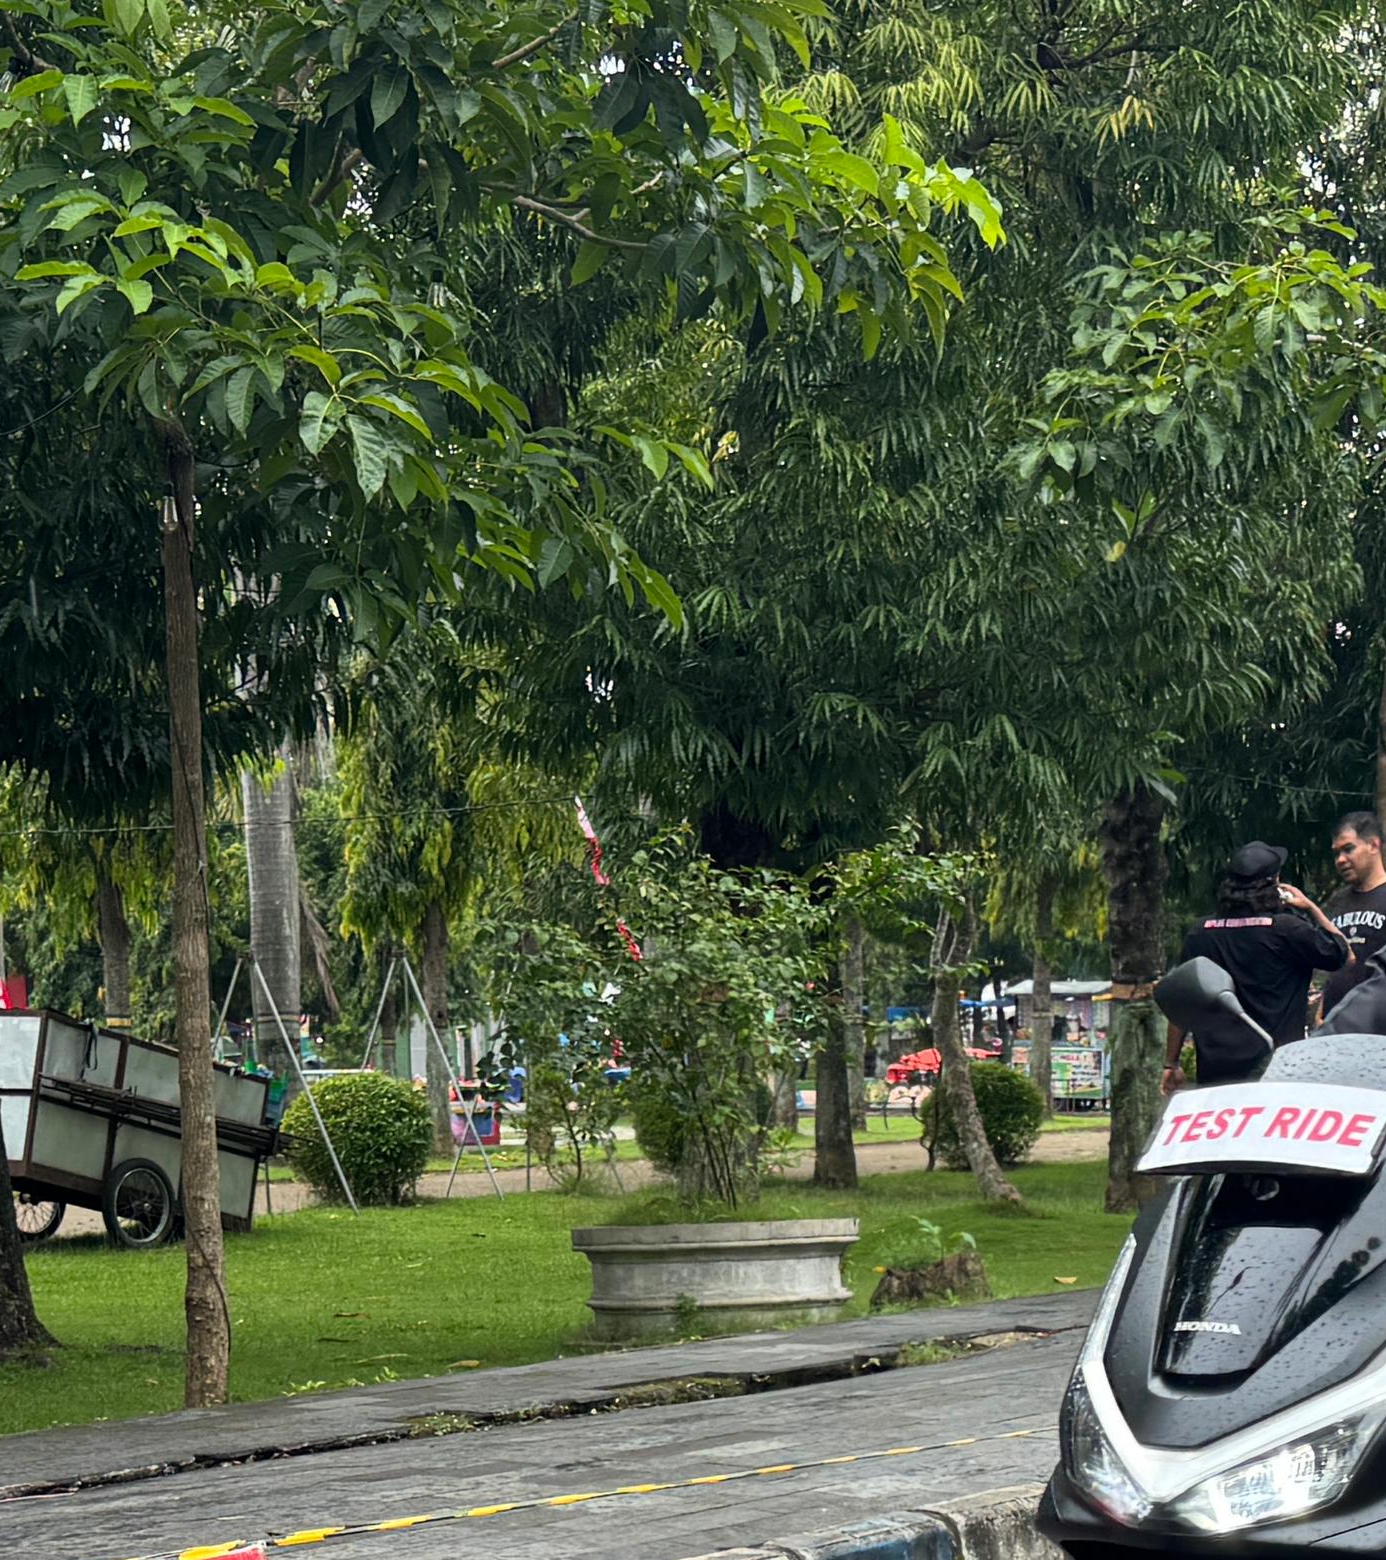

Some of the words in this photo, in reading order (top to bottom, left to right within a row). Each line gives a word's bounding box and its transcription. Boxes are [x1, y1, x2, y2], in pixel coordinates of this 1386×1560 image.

[1162, 1106, 1265, 1146] TEST
[1264, 1107, 1377, 1147] RIDE
[1173, 1321, 1242, 1336] HONDA
